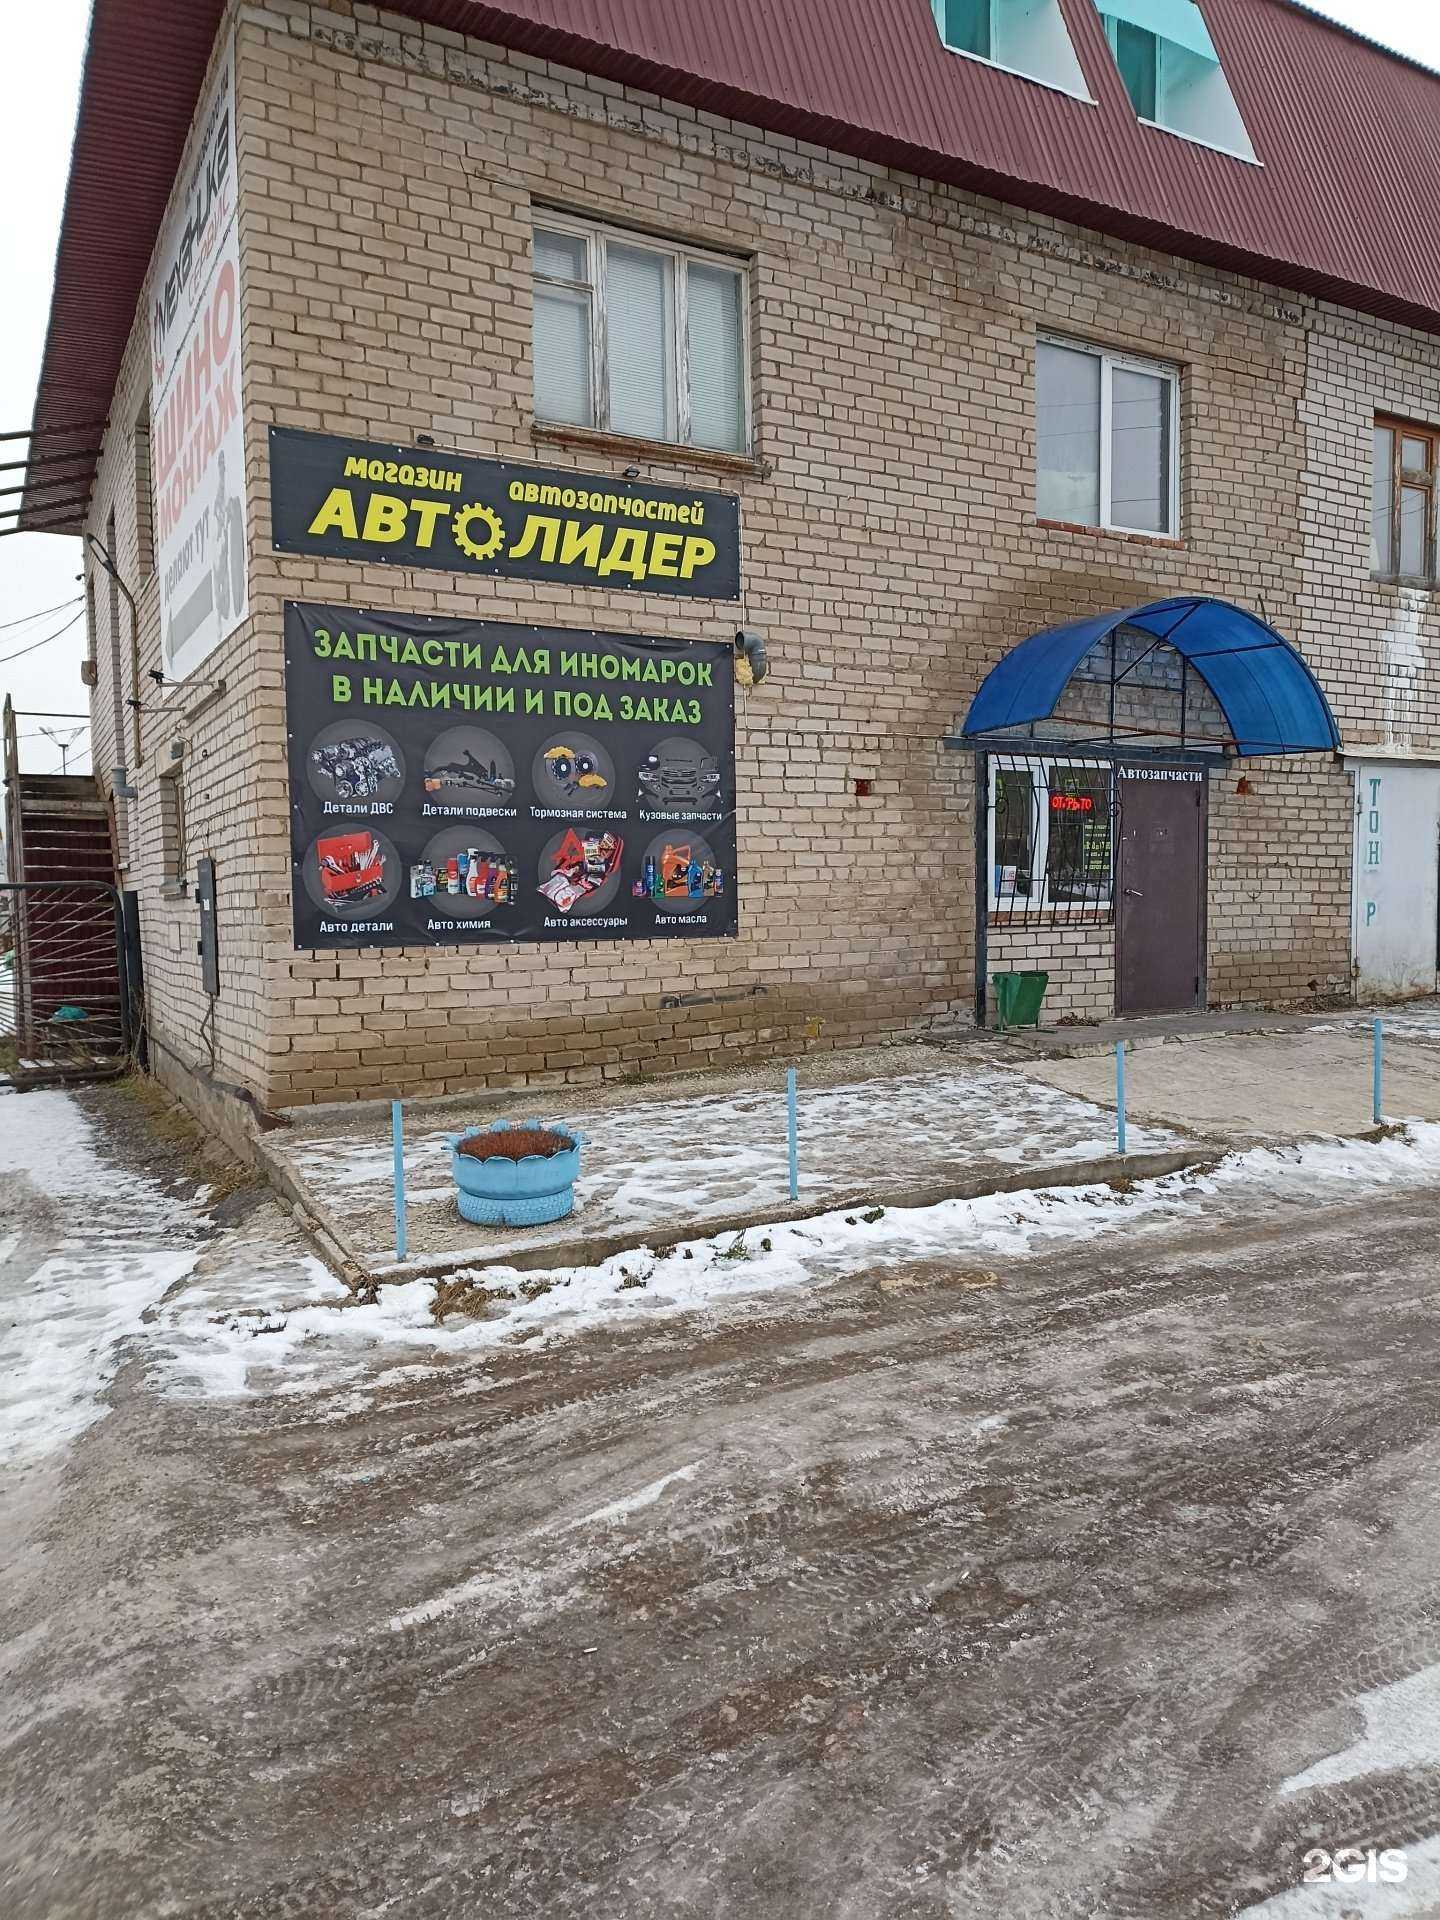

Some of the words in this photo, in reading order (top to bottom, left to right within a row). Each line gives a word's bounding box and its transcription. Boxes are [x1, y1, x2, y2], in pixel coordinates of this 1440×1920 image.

[156, 259, 235, 491] ШИНО
[159, 349, 238, 549] МОНТАЖ
[344, 456, 462, 493] магазин
[509, 480, 705, 526] автозапчастей
[195, 505, 210, 573] тут
[314, 629, 482, 669] ЗАПЧАСТИ
[490, 645, 551, 675] ДЛЯ
[560, 650, 713, 687] ИНОМАРОК
[332, 675, 352, 702] В
[363, 677, 515, 713] НАЛИЧИИ
[525, 688, 544, 714] И
[553, 690, 614, 721] ПОД
[619, 695, 702, 724] ЗАКАЗ
[1117, 765, 1204, 782] Автозапчасти
[323, 801, 368, 814] Детали
[370, 802, 393, 814] ДВС
[422, 804, 463, 816] Детали
[466, 807, 517, 817] подвески
[529, 807, 583, 818] Тормозная
[586, 810, 627, 819] система
[639, 809, 680, 821] Кузовые
[681, 812, 722, 821] запчасти
[427, 918, 454, 930] Авто
[456, 920, 491, 929] химия
[543, 916, 568, 928] Авто
[569, 917, 628, 927] аксессуары
[655, 914, 677, 924] Авто
[678, 915, 707, 924] масла
[319, 921, 348, 932] Авто
[350, 922, 393, 933] детали
